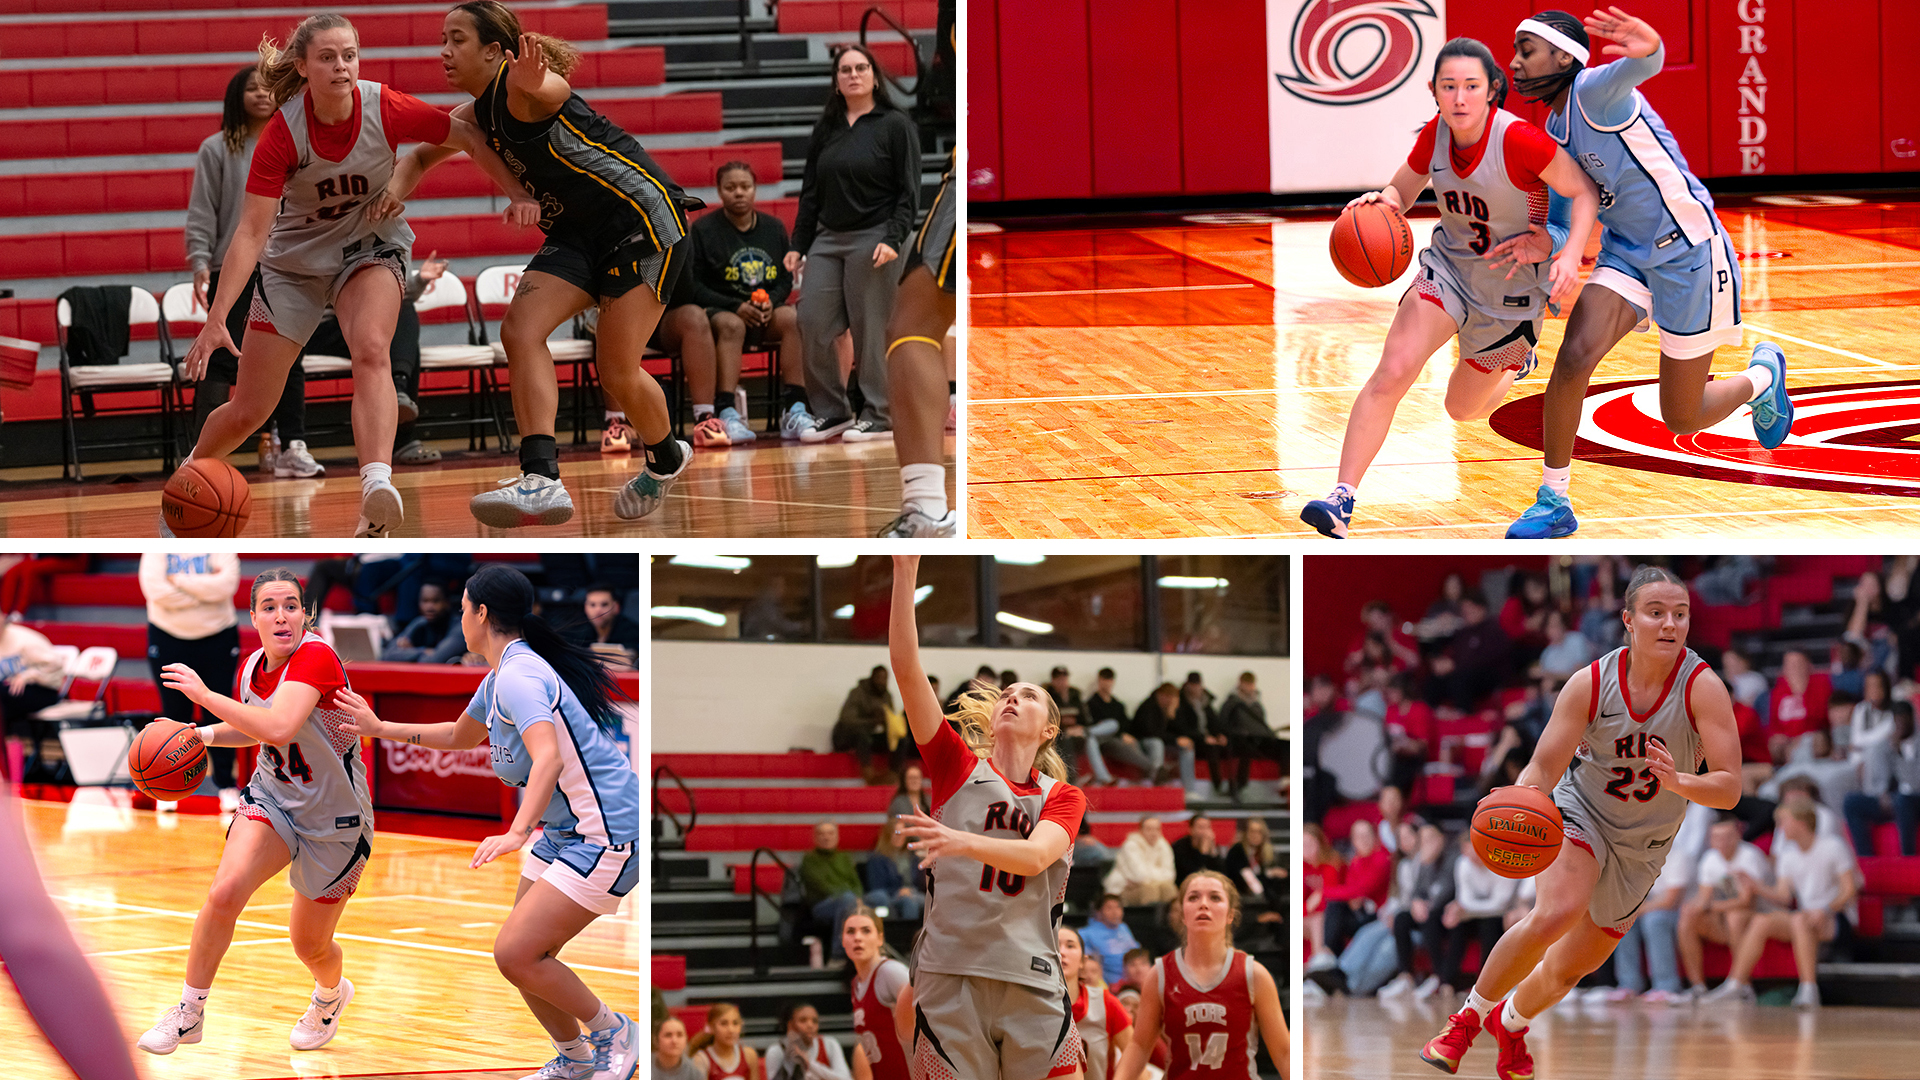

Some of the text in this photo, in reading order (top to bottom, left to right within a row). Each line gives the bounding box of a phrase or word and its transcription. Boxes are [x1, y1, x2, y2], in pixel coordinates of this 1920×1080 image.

[1737, 0, 1768, 175] GRANDE
[314, 173, 369, 202] RIO
[1442, 190, 1490, 222] RIO
[1468, 221, 1491, 256] 3
[724, 266, 740, 280] 25
[765, 265, 777, 280] 26
[1716, 269, 1728, 293] P
[266, 742, 314, 785] 24
[1603, 766, 1661, 803] 23
[983, 800, 1035, 840] RIO
[1487, 816, 1548, 842] SPALDING
[1485, 843, 1541, 862] LEGACY
[1183, 1032, 1229, 1071] 14
